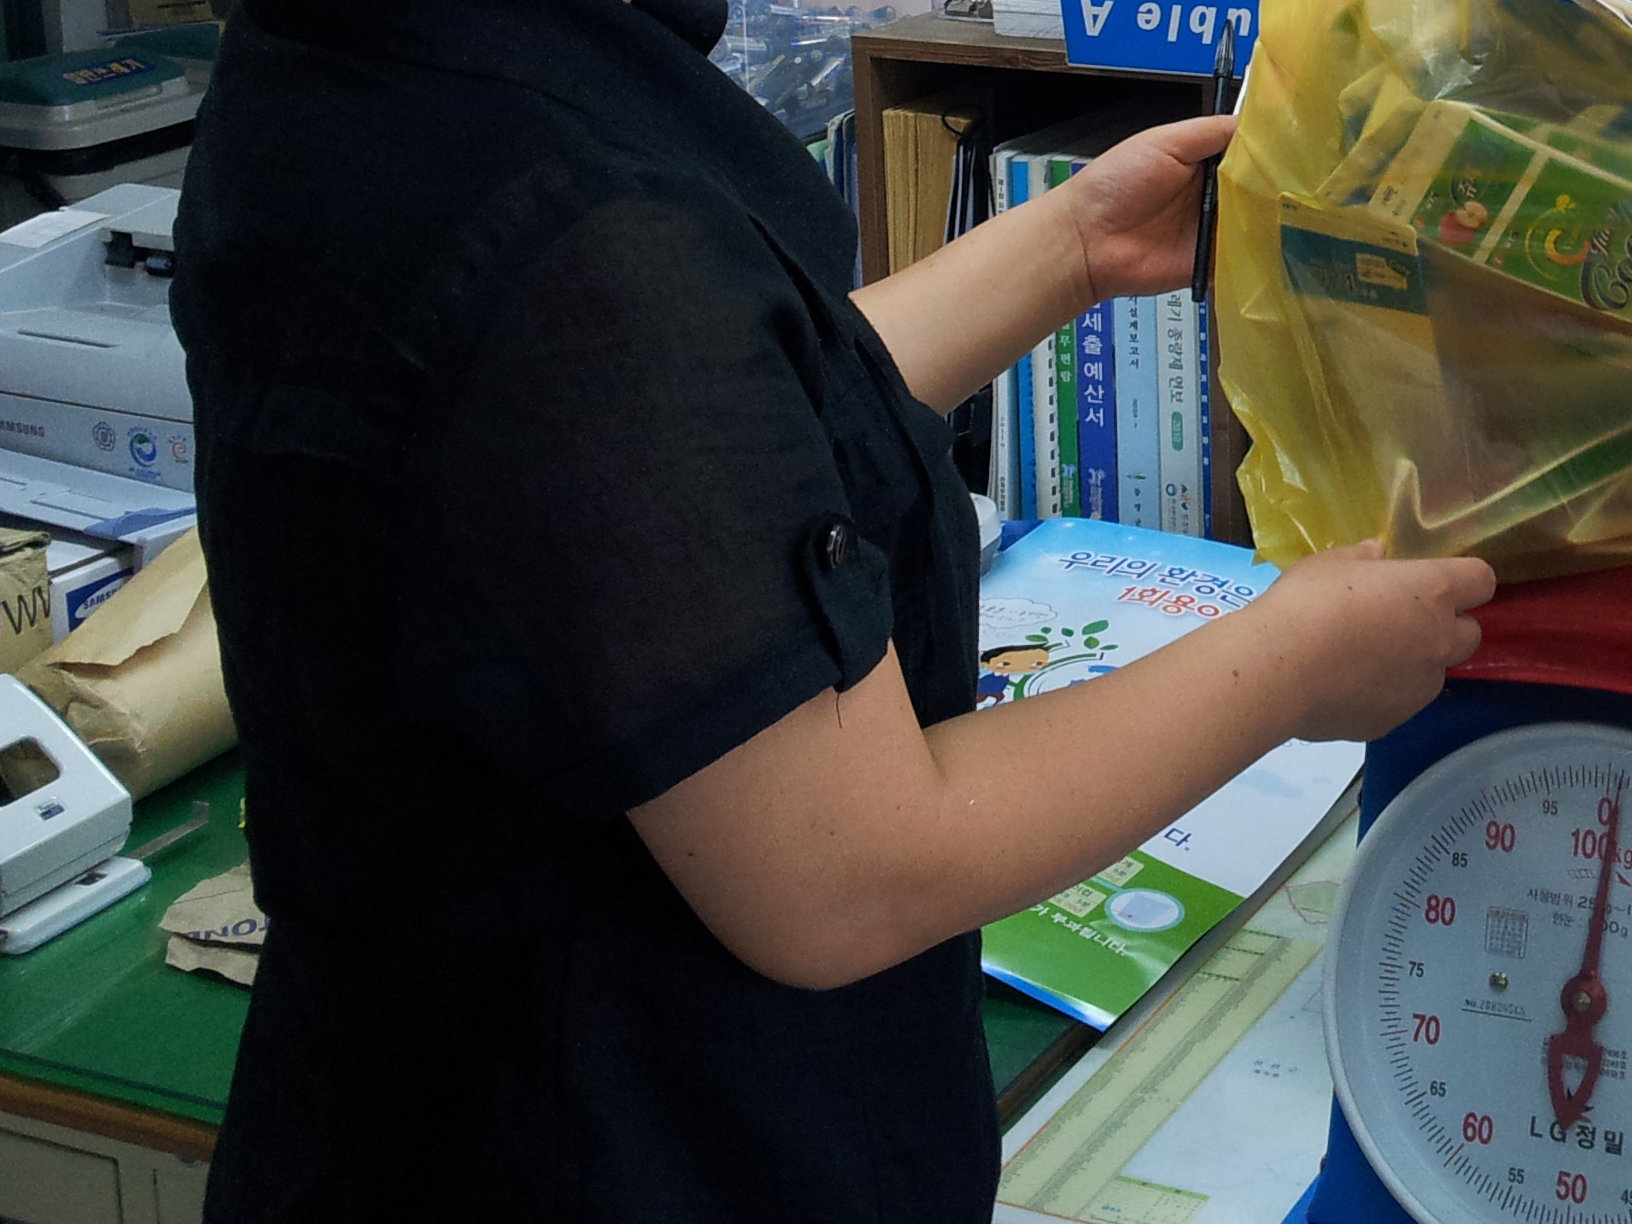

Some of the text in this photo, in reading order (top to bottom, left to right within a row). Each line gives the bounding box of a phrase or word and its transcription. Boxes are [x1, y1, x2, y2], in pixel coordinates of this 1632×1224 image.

[1058, 550, 1256, 609] 우리의 환경은
[1542, 799, 1559, 815] 95
[1597, 796, 1615, 826] 0
[1485, 820, 1516, 853] 90
[1451, 851, 1469, 868] 85
[1424, 893, 1456, 927] 80
[1408, 960, 1425, 978] 75
[1412, 1013, 1441, 1045] 70
[1429, 1079, 1447, 1098] 65
[1462, 1111, 1494, 1145] 60
[1507, 1166, 1525, 1185] 55
[1555, 1170, 1587, 1204] 50
